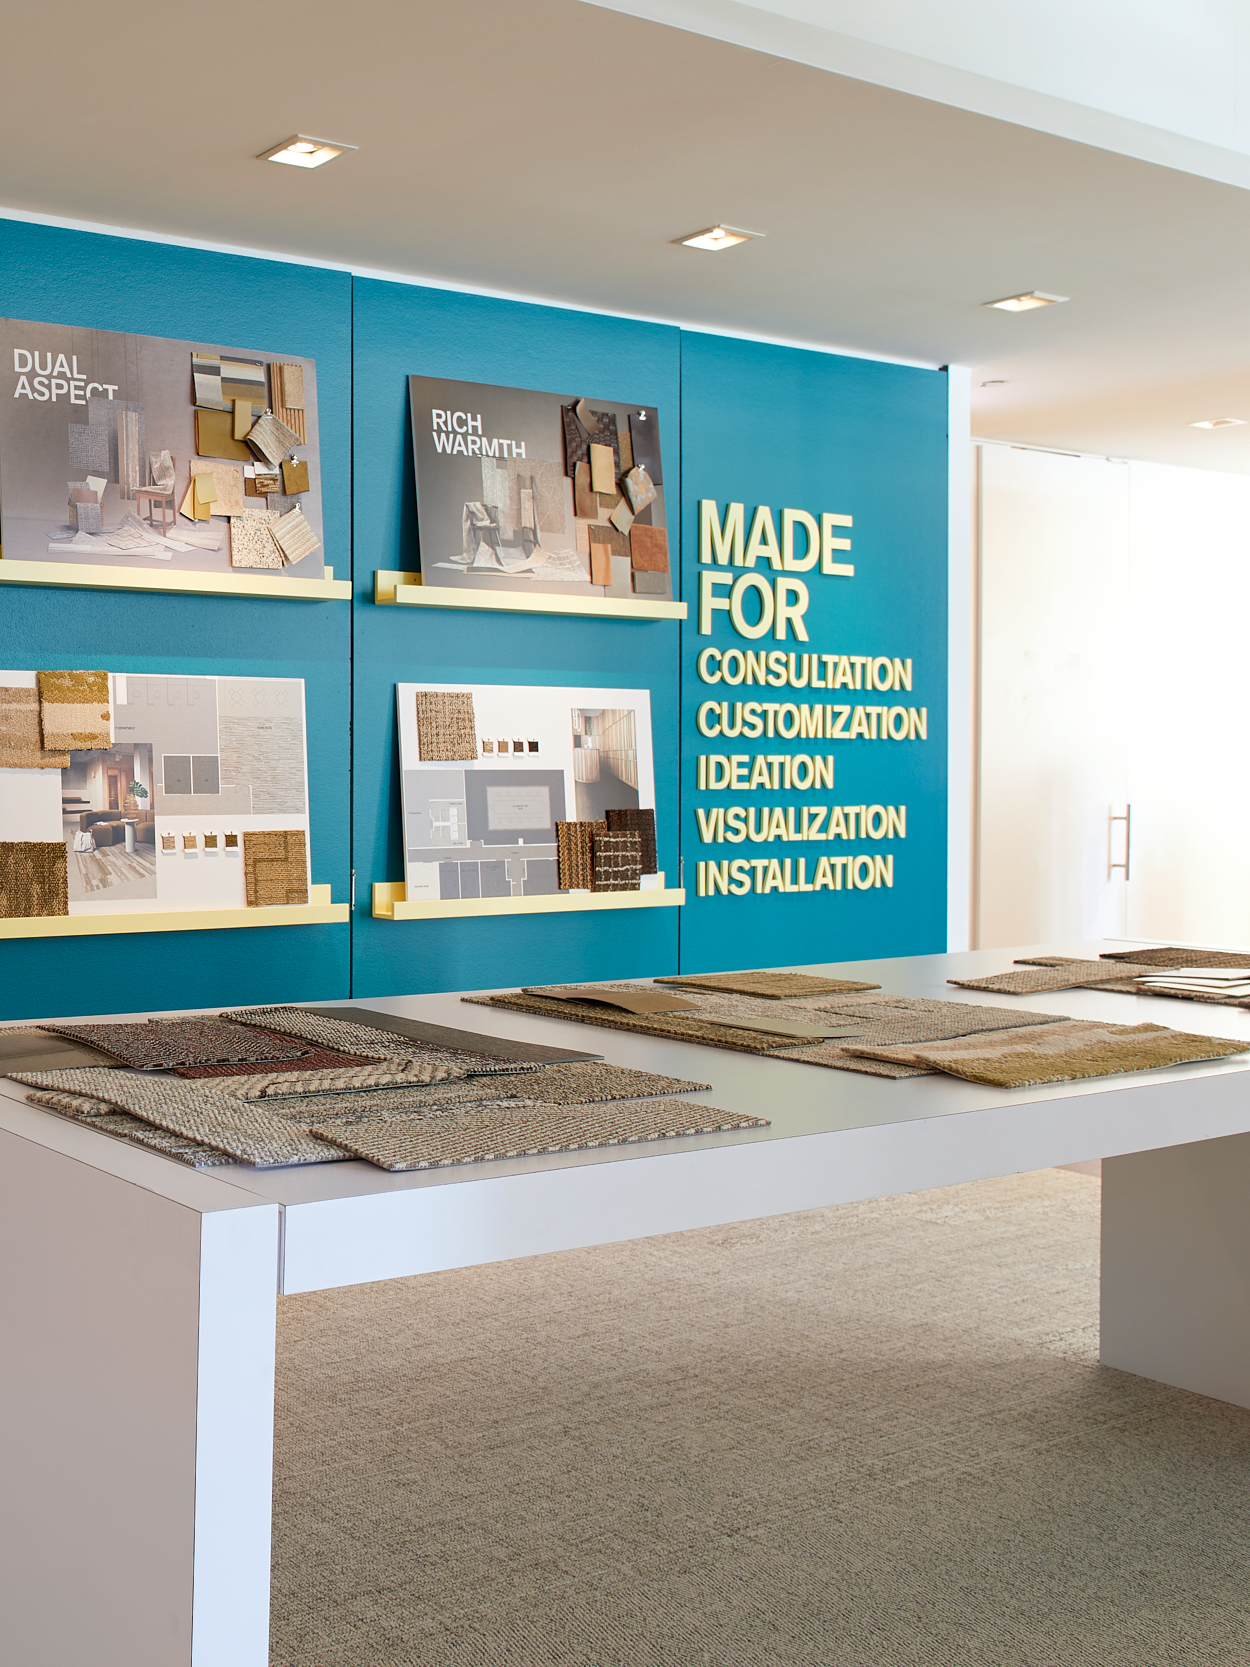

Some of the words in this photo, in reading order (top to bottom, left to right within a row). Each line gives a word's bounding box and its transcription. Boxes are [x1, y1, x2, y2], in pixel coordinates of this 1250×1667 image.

[13, 348, 87, 380] DUAL
[13, 375, 119, 405] ASPECT
[432, 408, 482, 435] RICH
[432, 431, 526, 459] WARMTH
[698, 499, 855, 577] MADE
[698, 570, 810, 642] FOR
[697, 647, 913, 691] CONSULTATION
[696, 700, 928, 741] CUSTOMIZATION
[696, 754, 835, 790] IDEATION
[694, 804, 907, 844] VISUALIZATION
[696, 854, 894, 897] INSTALLATION
